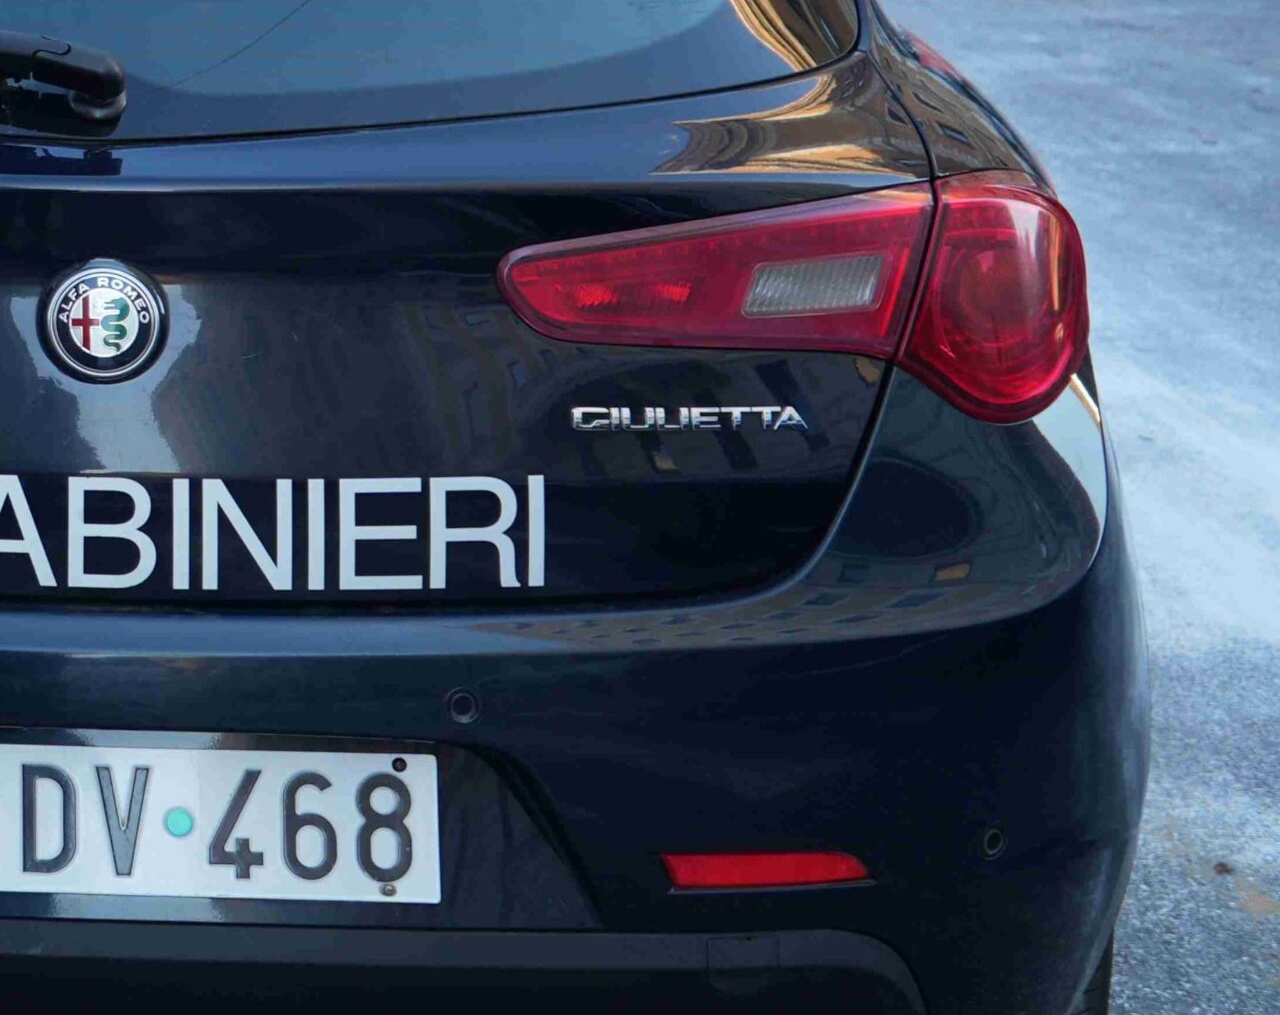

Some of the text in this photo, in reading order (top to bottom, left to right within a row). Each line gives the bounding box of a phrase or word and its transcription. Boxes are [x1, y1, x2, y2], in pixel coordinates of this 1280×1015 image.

[58, 276, 150, 324] ALFA ROMEO
[571, 405, 809, 432] GIULIETTA
[20, 761, 151, 878] DV
[207, 768, 414, 885] 468
